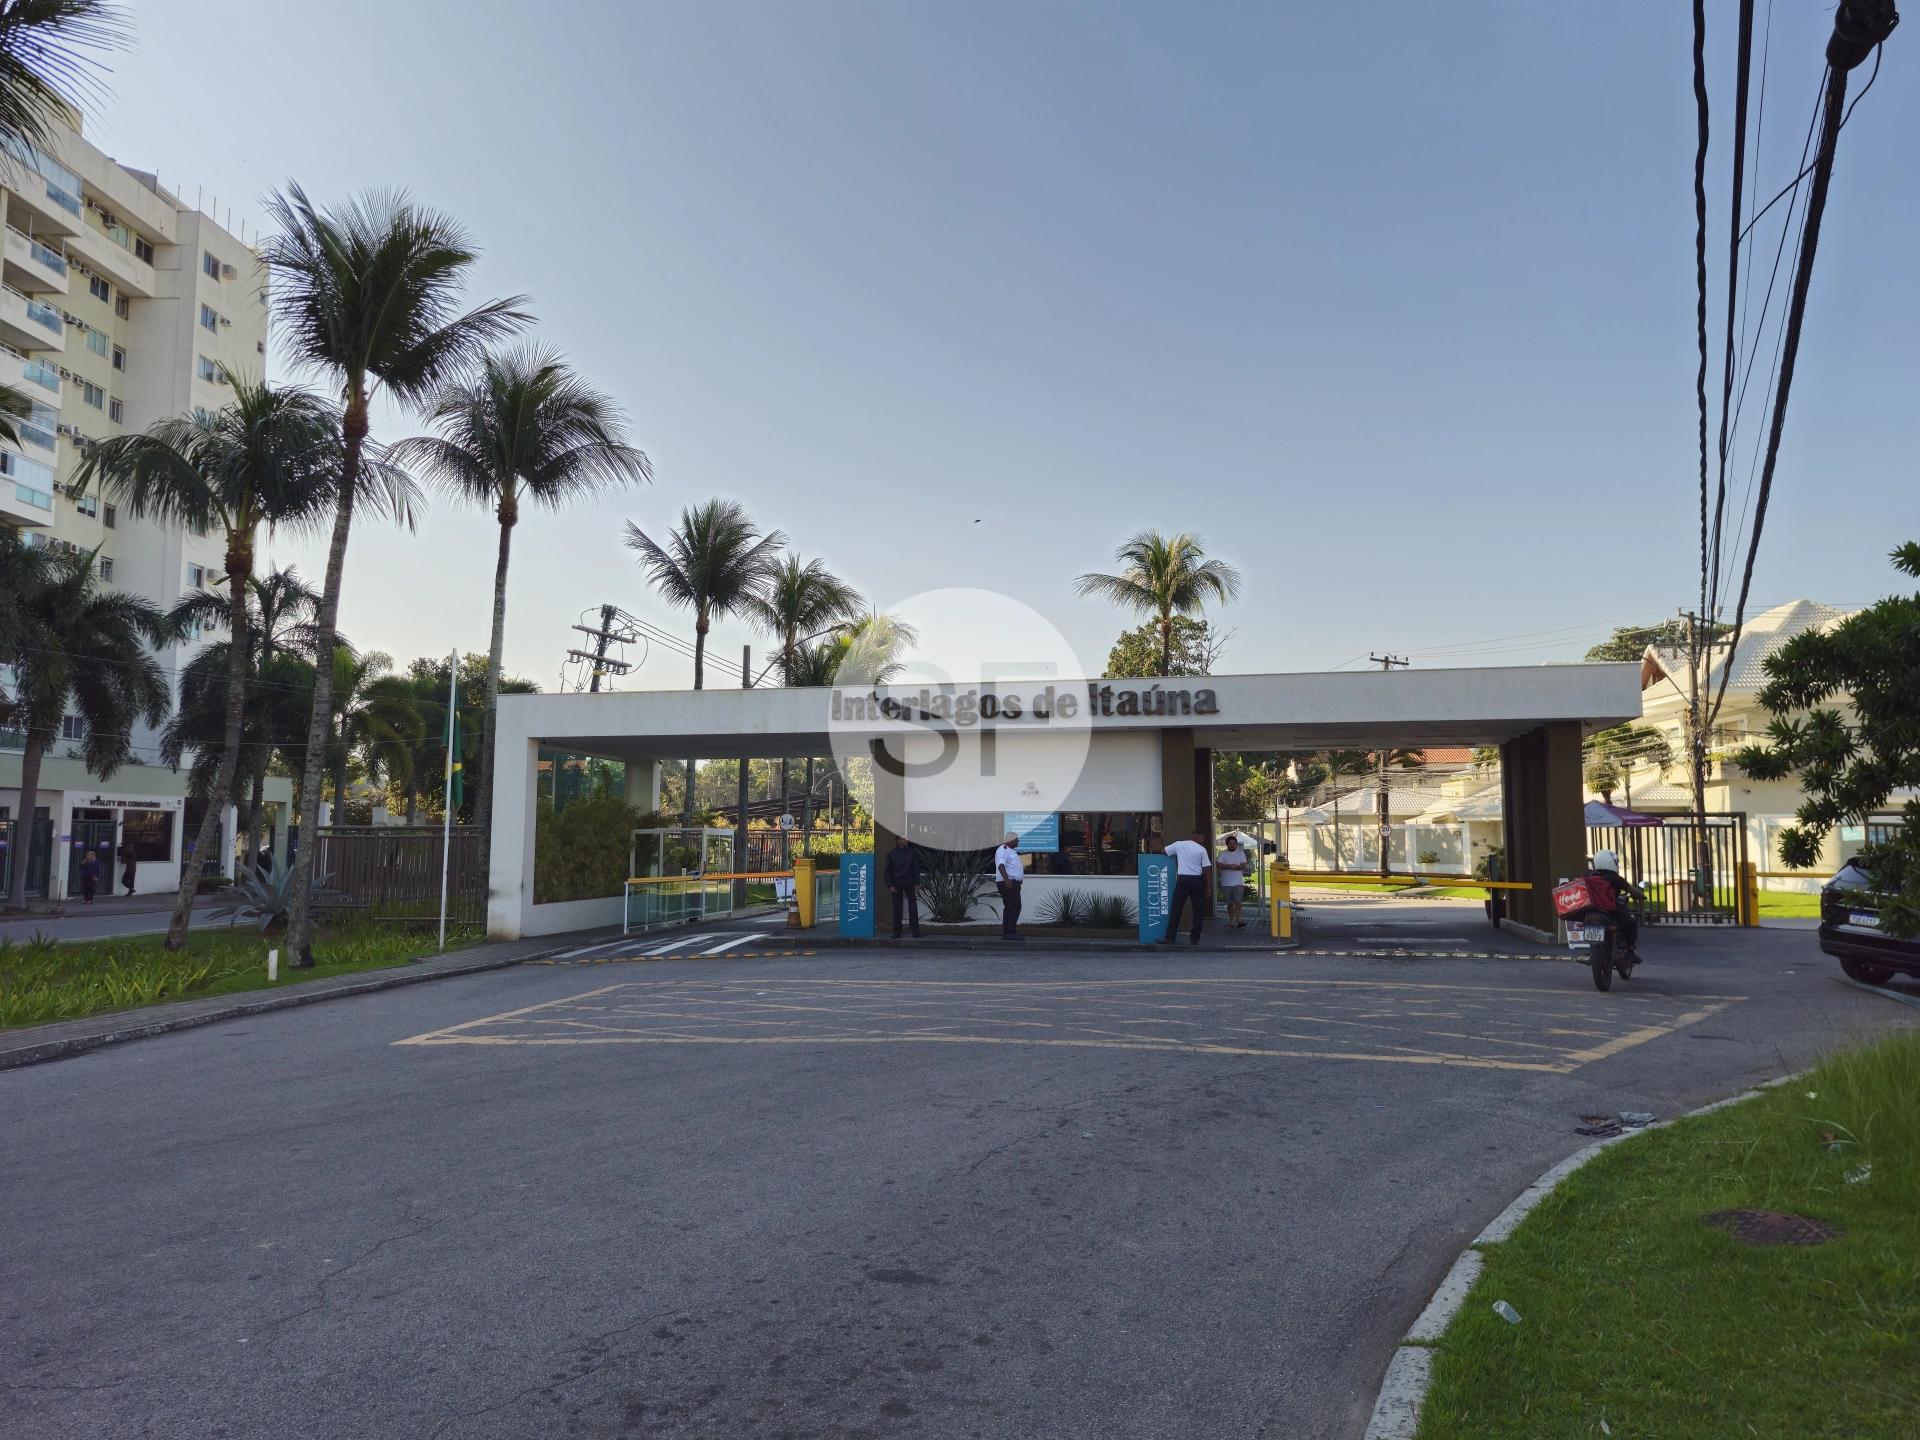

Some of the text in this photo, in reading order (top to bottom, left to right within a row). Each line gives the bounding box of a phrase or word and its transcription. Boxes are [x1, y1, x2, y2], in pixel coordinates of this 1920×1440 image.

[831, 683, 1220, 727] Interlagos de Itaúna
[89, 799, 116, 807] VITALITY
[846, 863, 859, 922] VEÍCULO
[1145, 864, 1160, 928] VEÍCULO
